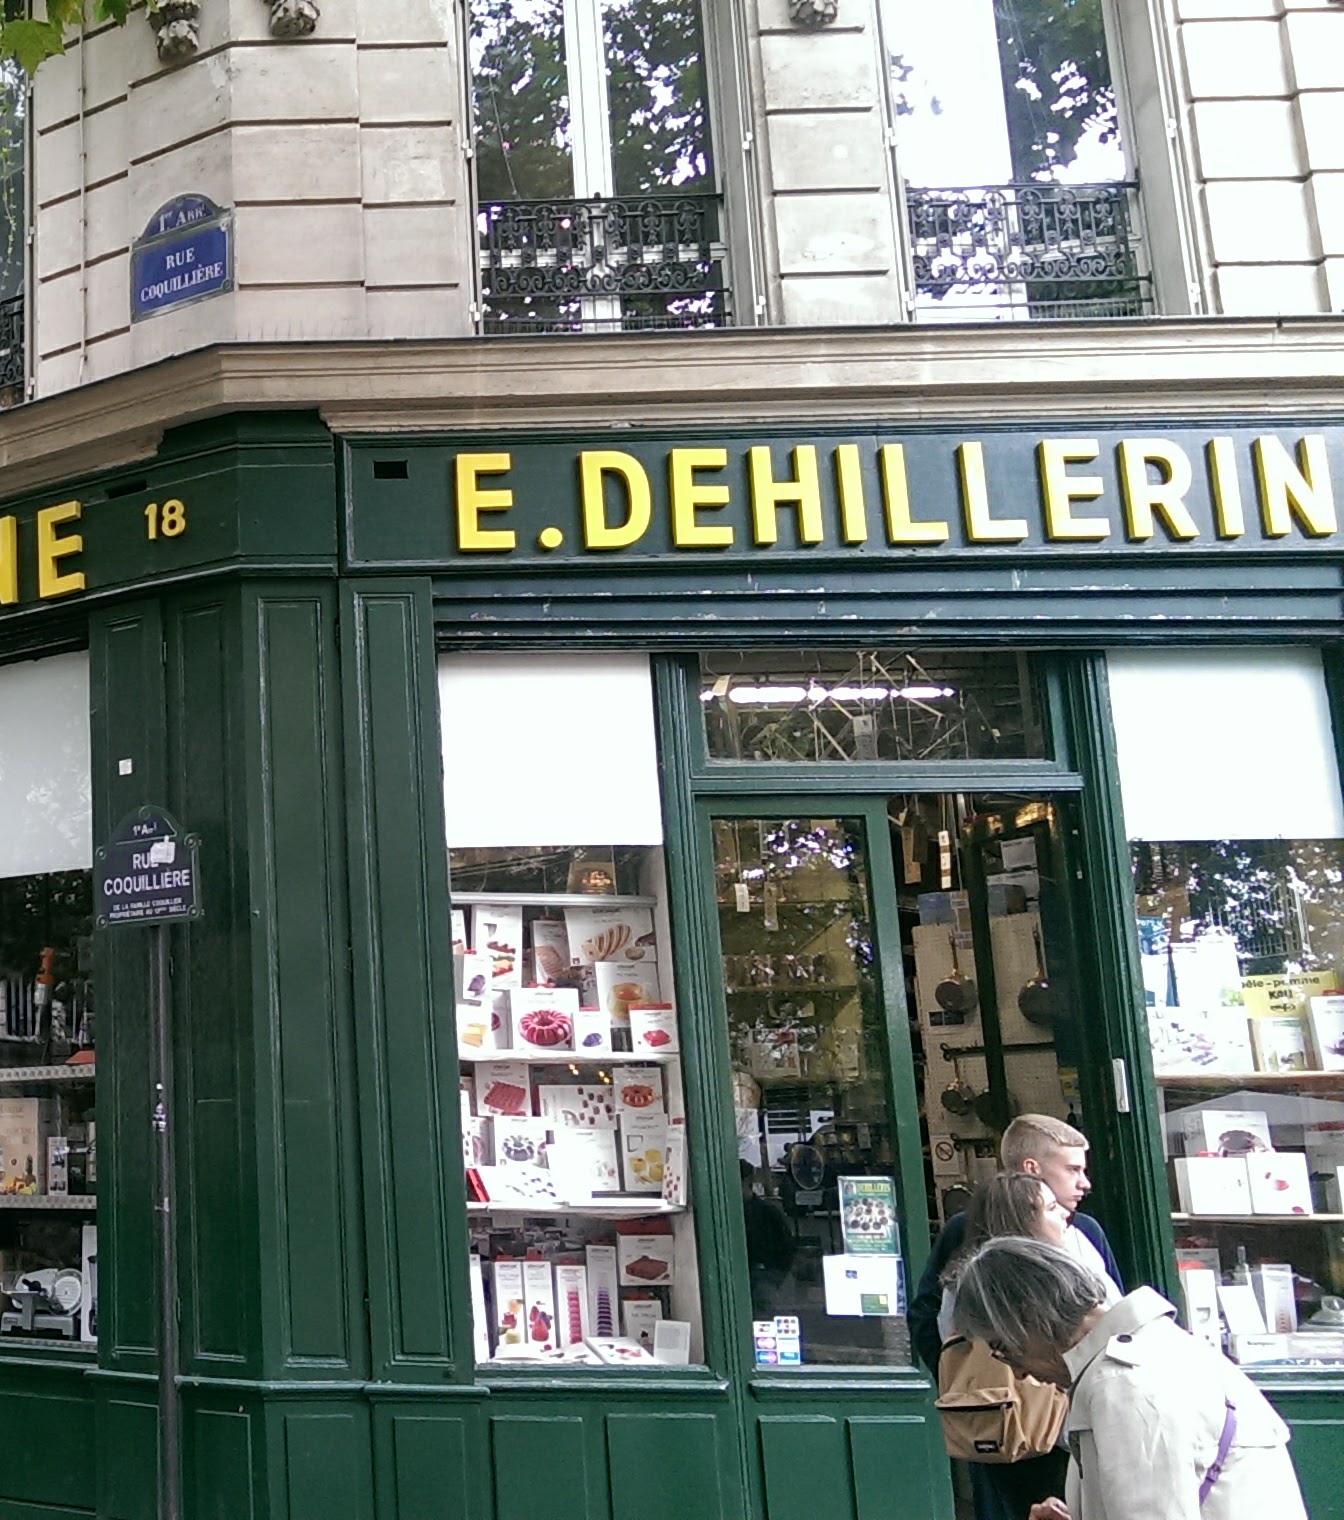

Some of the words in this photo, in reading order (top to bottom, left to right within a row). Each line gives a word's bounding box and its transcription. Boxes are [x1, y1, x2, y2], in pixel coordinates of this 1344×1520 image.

[165, 247, 195, 271] RUE
[140, 262, 224, 302] COQUILLIÈRE
[144, 499, 187, 540] 18
[103, 867, 190, 896] COQUILLIÈRE
